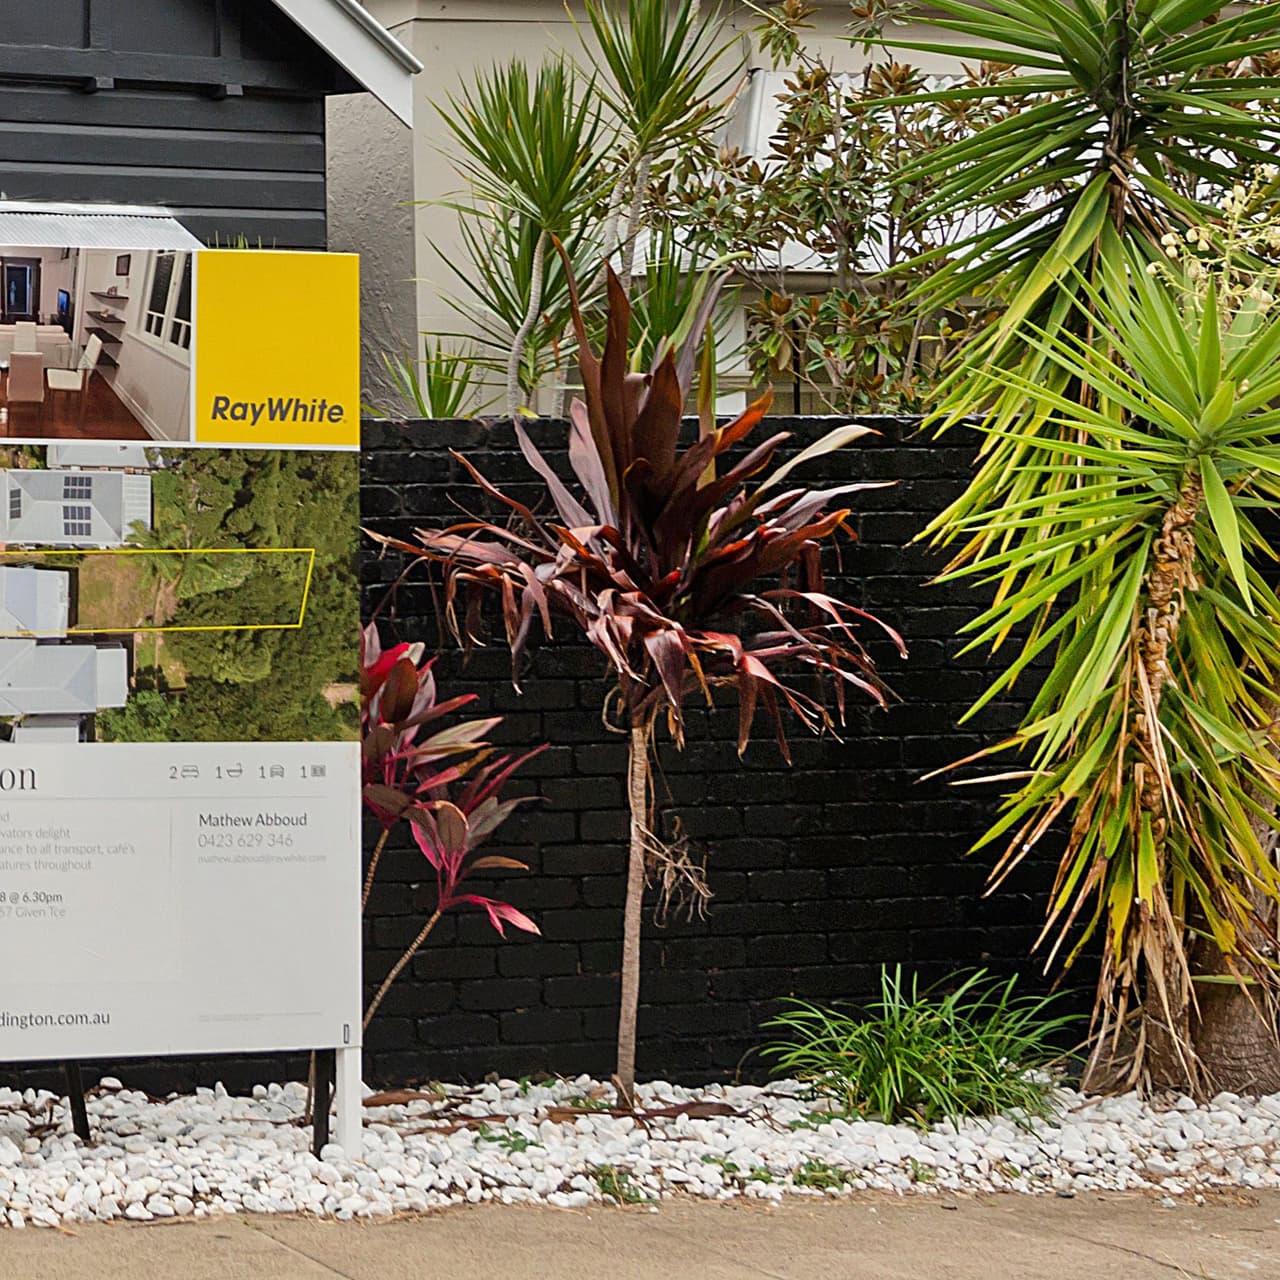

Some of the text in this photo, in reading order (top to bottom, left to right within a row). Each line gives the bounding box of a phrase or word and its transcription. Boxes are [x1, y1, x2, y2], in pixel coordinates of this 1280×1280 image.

[211, 395, 344, 426] RayWhite
[169, 766, 178, 779] 2
[215, 766, 222, 779] 1
[259, 766, 266, 779] 1
[300, 766, 307, 779] 1
[199, 813, 307, 827] Mathew Abboud
[35, 827, 71, 841] delight
[198, 833, 293, 847] 0423 629 346
[26, 844, 37, 855] to
[40, 843, 51, 855] all
[34, 859, 92, 873] throughout
[9, 893, 20, 904] @
[22, 892, 63, 905] 6.30pm
[15, 907, 46, 918] Given
[49, 907, 66, 918] Tce
